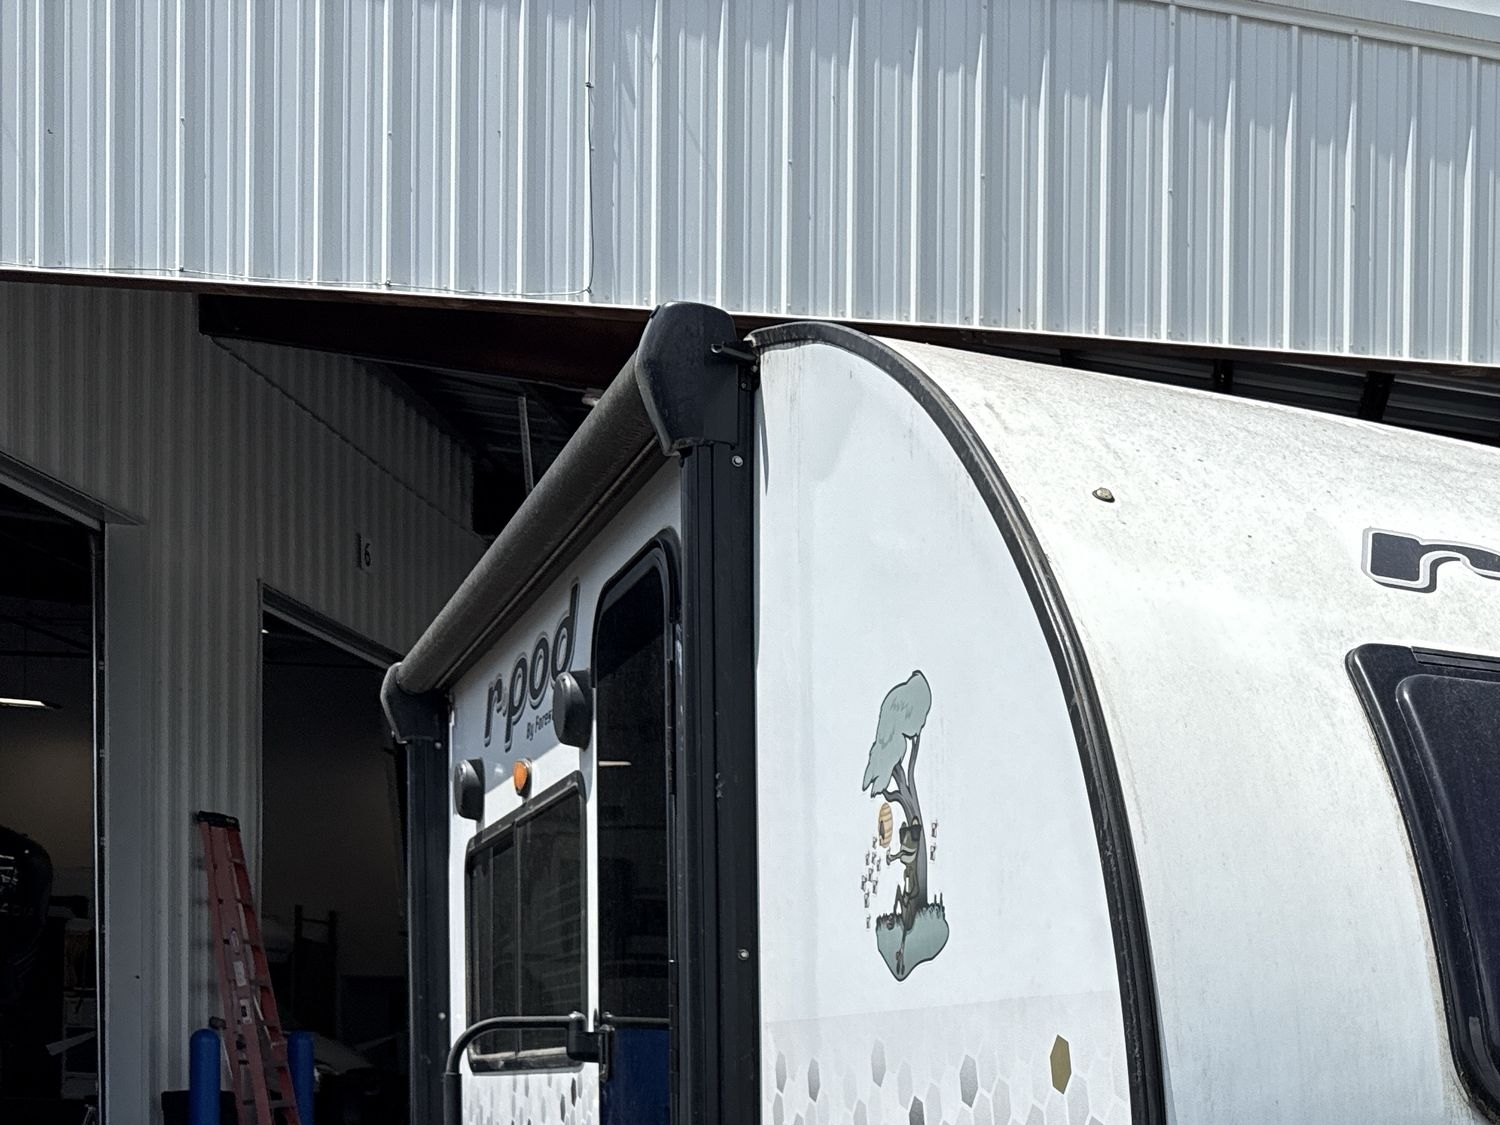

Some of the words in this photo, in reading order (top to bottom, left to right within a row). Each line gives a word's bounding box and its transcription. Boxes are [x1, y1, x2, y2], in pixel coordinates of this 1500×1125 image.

[364, 543, 371, 567] 6
[526, 721, 534, 742] By
[535, 709, 553, 734] Fores
